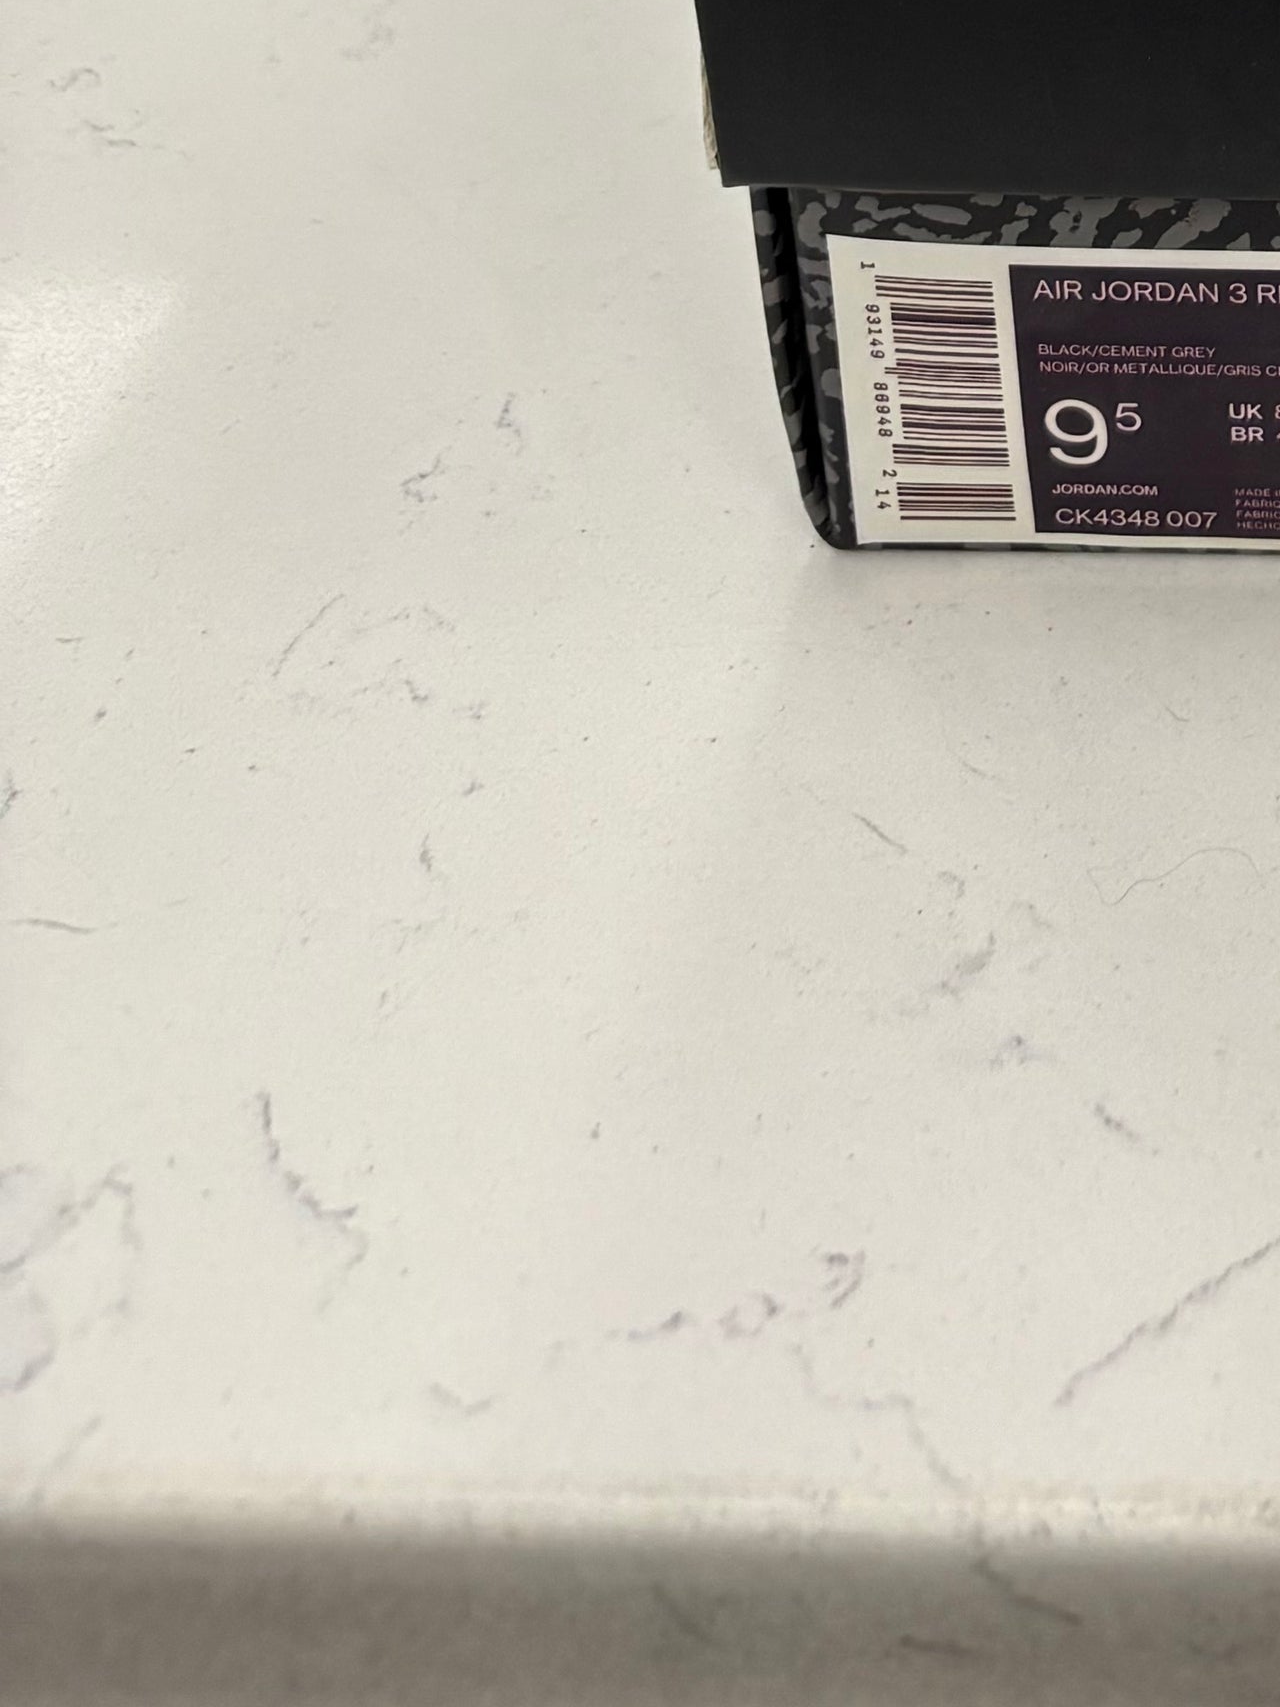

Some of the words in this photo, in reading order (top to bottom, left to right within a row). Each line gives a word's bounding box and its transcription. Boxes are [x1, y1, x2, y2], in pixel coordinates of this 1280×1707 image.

[1033, 279, 1083, 301] AIR
[1092, 280, 1220, 304] JORDAN
[1229, 282, 1248, 305] 3
[1038, 343, 1168, 358] BLACK/CEMENT
[1171, 346, 1217, 359] GREY
[1039, 361, 1110, 375] NOIR/OR
[1114, 363, 1262, 378] METALLIQUE/GRIS
[1228, 402, 1264, 420] UK
[1230, 426, 1265, 443] BR
[1052, 483, 1159, 497] JORDAN.COM
[1234, 488, 1271, 497] MADE
[1055, 507, 1161, 527] CK4348
[1166, 511, 1219, 529] 007
